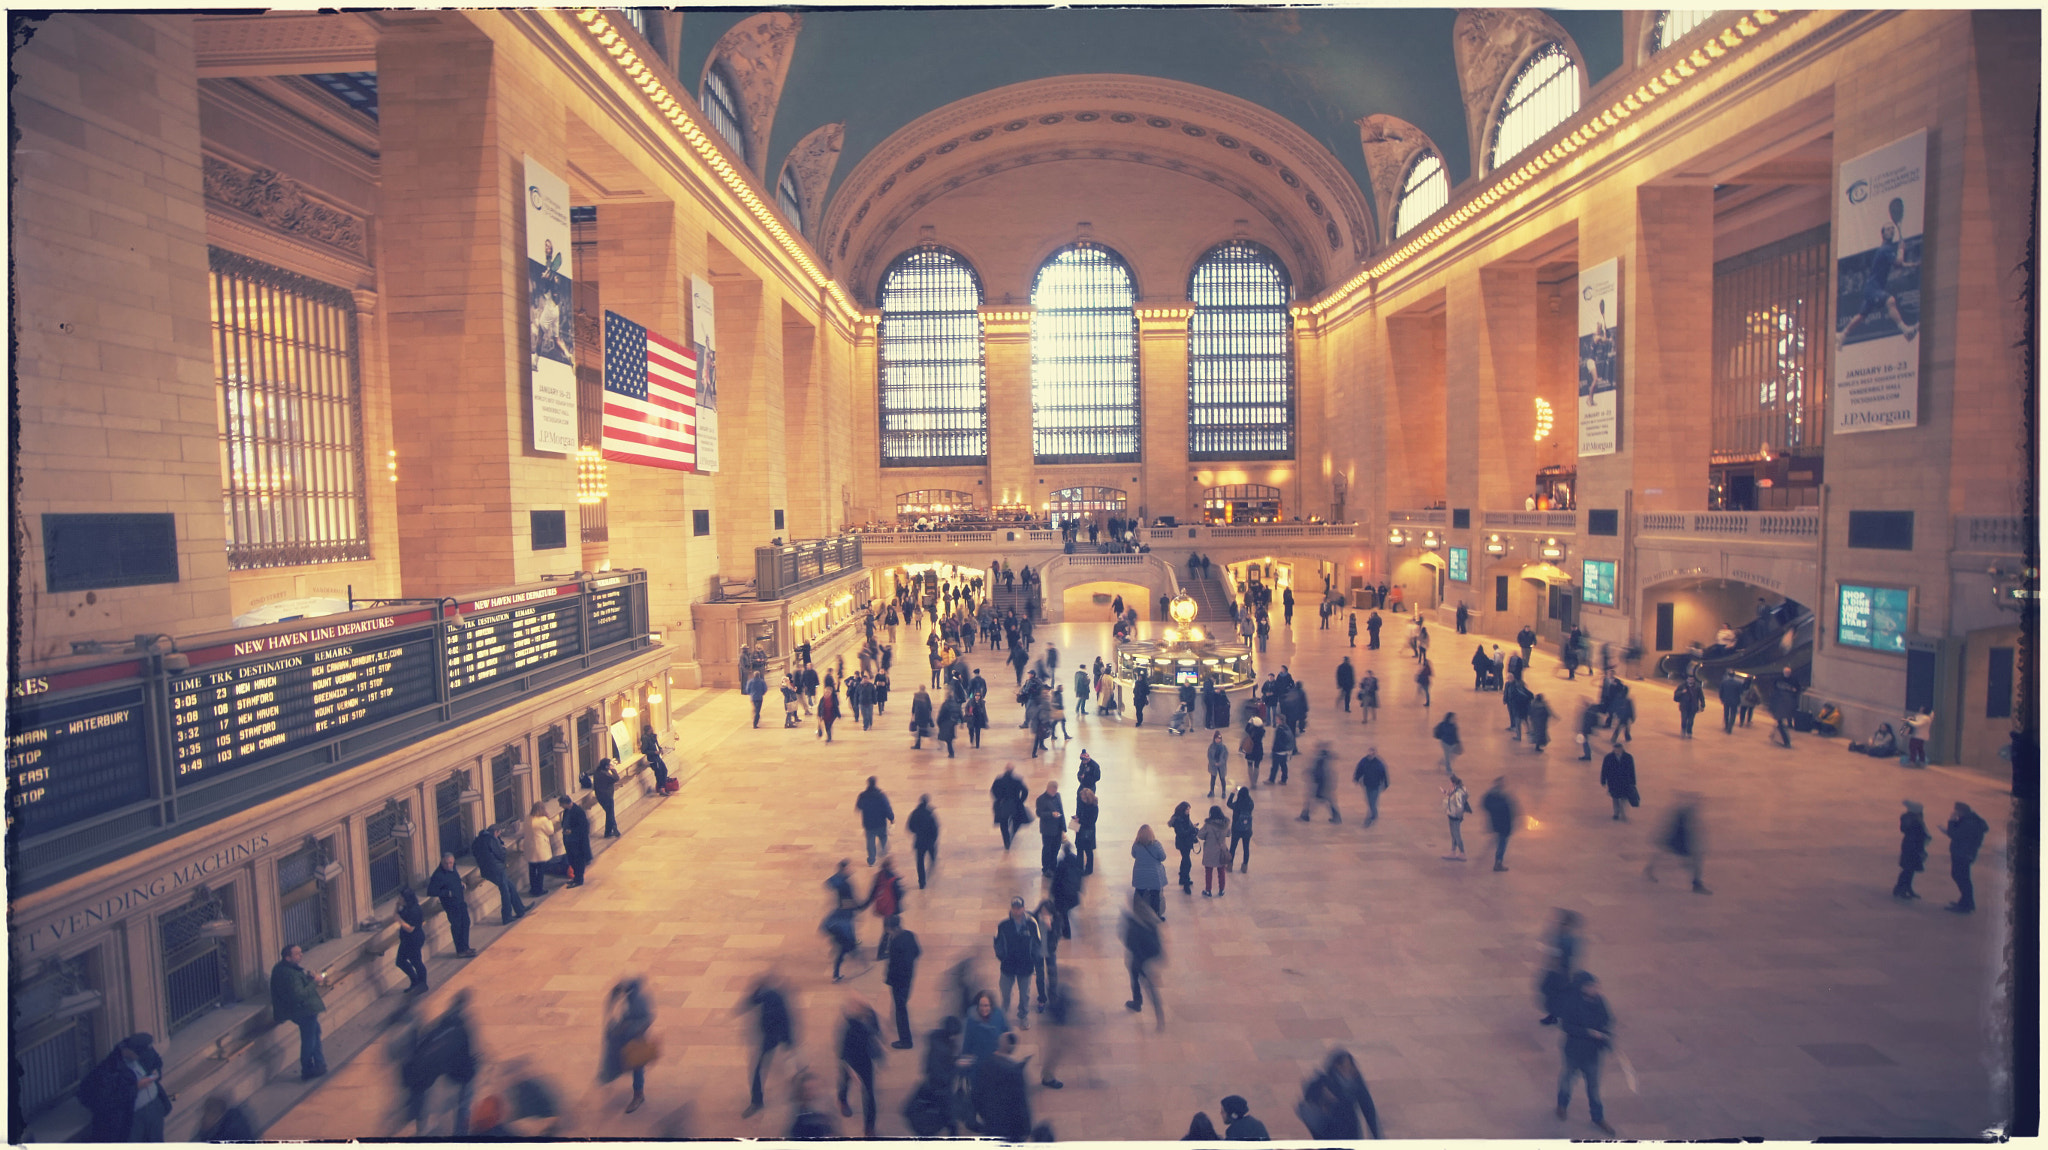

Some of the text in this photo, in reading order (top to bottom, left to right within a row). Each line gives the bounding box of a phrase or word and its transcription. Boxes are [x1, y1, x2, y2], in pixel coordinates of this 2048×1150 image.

[1846, 366, 1881, 379] JANUARY
[474, 588, 558, 610] NEW HAVEN LINE DEPARTURES
[478, 613, 510, 626] DESTINATION
[234, 616, 395, 656] NEW HAVEN LINE DEPARTURES
[172, 646, 352, 692] TIME TRK DESTINATION REMARKS
[312, 666, 324, 676] NEW
[312, 676, 332, 690] MOUNT
[335, 671, 357, 684] VERNON
[366, 666, 376, 676] 1ST
[378, 662, 392, 674] STOP
[174, 676, 277, 710] 3:05 23 NEW HAVEN
[314, 687, 348, 704] GREENWICH
[357, 682, 367, 692] 1ST
[370, 678, 383, 688] STOP
[314, 704, 334, 718] MOUNT
[336, 697, 358, 711] VERNON
[368, 692, 378, 702] 1ST
[380, 687, 394, 698] STOP
[70, 710, 129, 735] WATERBURY
[176, 710, 198, 726] 3:08
[236, 692, 274, 710] STAMFORD
[316, 720, 328, 732] RYE
[338, 714, 348, 724] 1ST
[351, 708, 366, 720] STOP
[178, 705, 280, 742] 3:32 17 NEW HAVEN
[179, 720, 276, 758] 3:35 105 STAMFORD
[10, 750, 42, 768] STOP
[180, 732, 286, 774] 3:49 103 NEW CANAAN
[19, 766, 50, 786] EAST
[14, 788, 44, 808] STOP
[50, 877, 166, 940] VENDING
[172, 832, 270, 888] MACHINES
